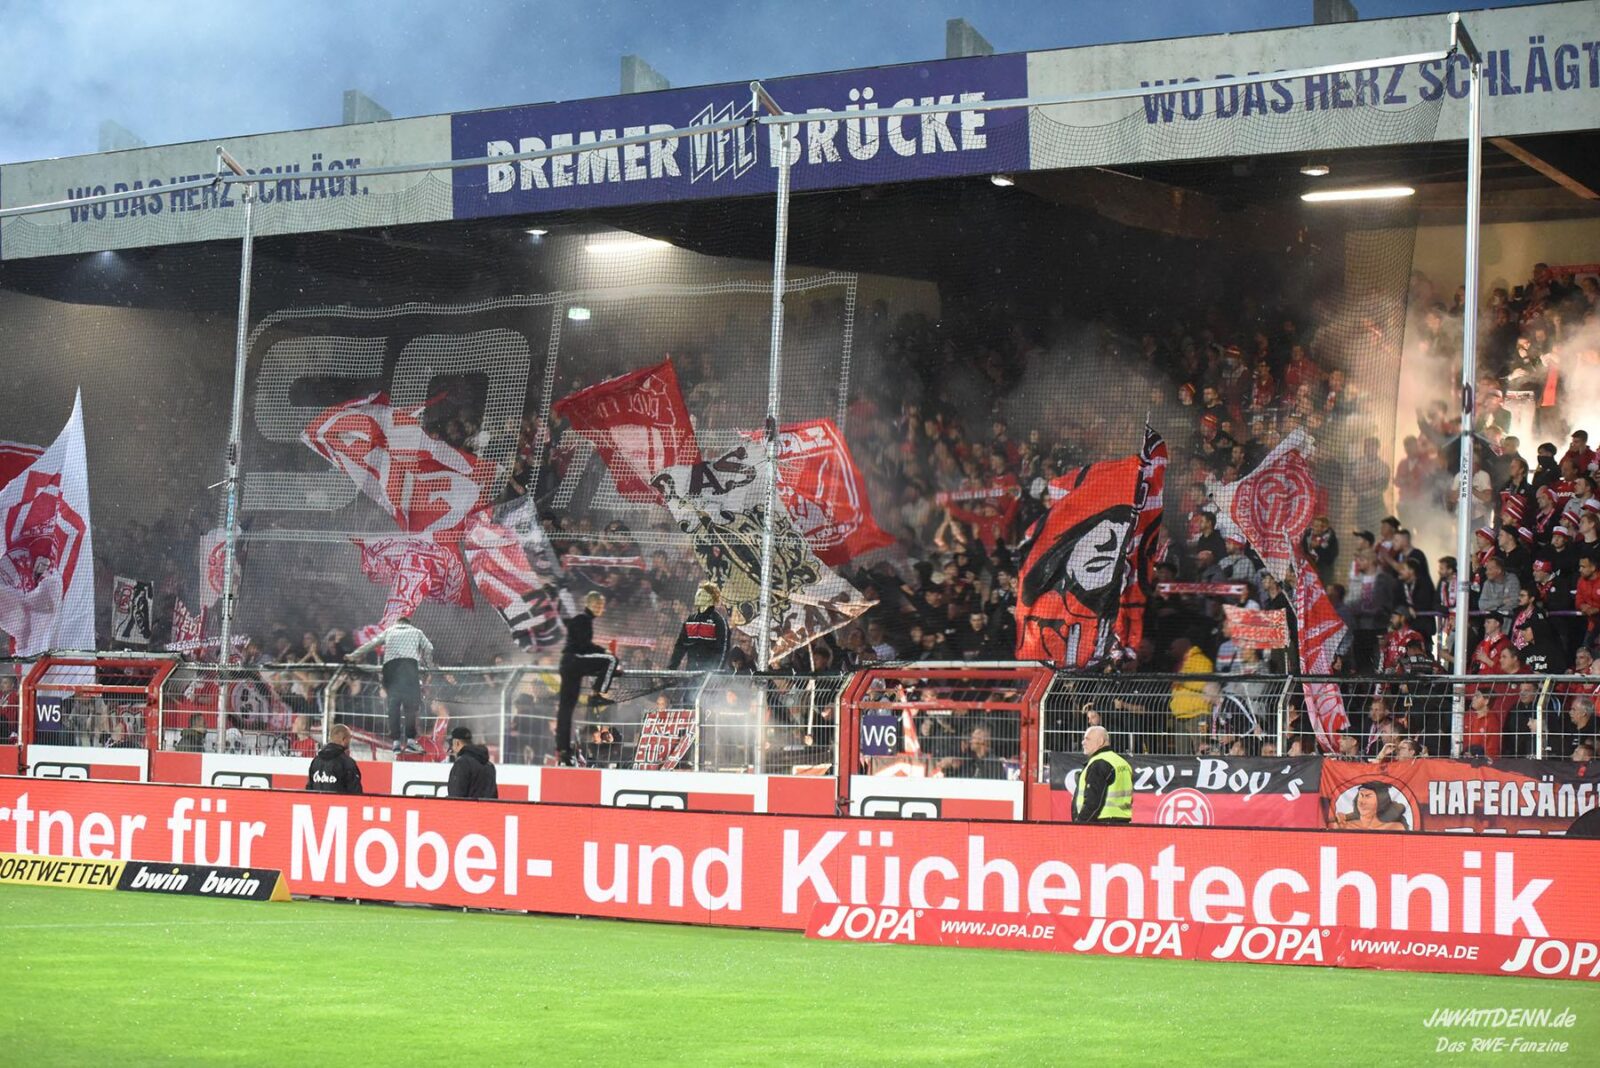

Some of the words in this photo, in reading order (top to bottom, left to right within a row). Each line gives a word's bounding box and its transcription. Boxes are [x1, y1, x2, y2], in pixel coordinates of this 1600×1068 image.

[1140, 76, 1202, 125] WO
[1213, 69, 1296, 119] DAS
[1304, 64, 1408, 112] HERZ
[486, 123, 682, 193] BREMER
[768, 87, 988, 168] BRÜCKE
[68, 184, 107, 223] WO
[113, 178, 164, 219] DAS
[170, 170, 235, 214] HERZ
[37, 704, 61, 723] W5
[863, 724, 897, 747] W6
[1429, 775, 1600, 818] HAFENSÄNG
[0, 858, 119, 886] ORTWETTEN
[130, 866, 189, 891] bwin
[200, 871, 260, 896] bwin
[167, 797, 266, 869] für
[291, 803, 552, 896] Möbel-
[583, 827, 744, 911] und
[782, 829, 1554, 938] Küchentechnik
[940, 920, 1055, 940] WWW.JOPA.DE
[1350, 939, 1479, 960] WWW.JOPA.DE
